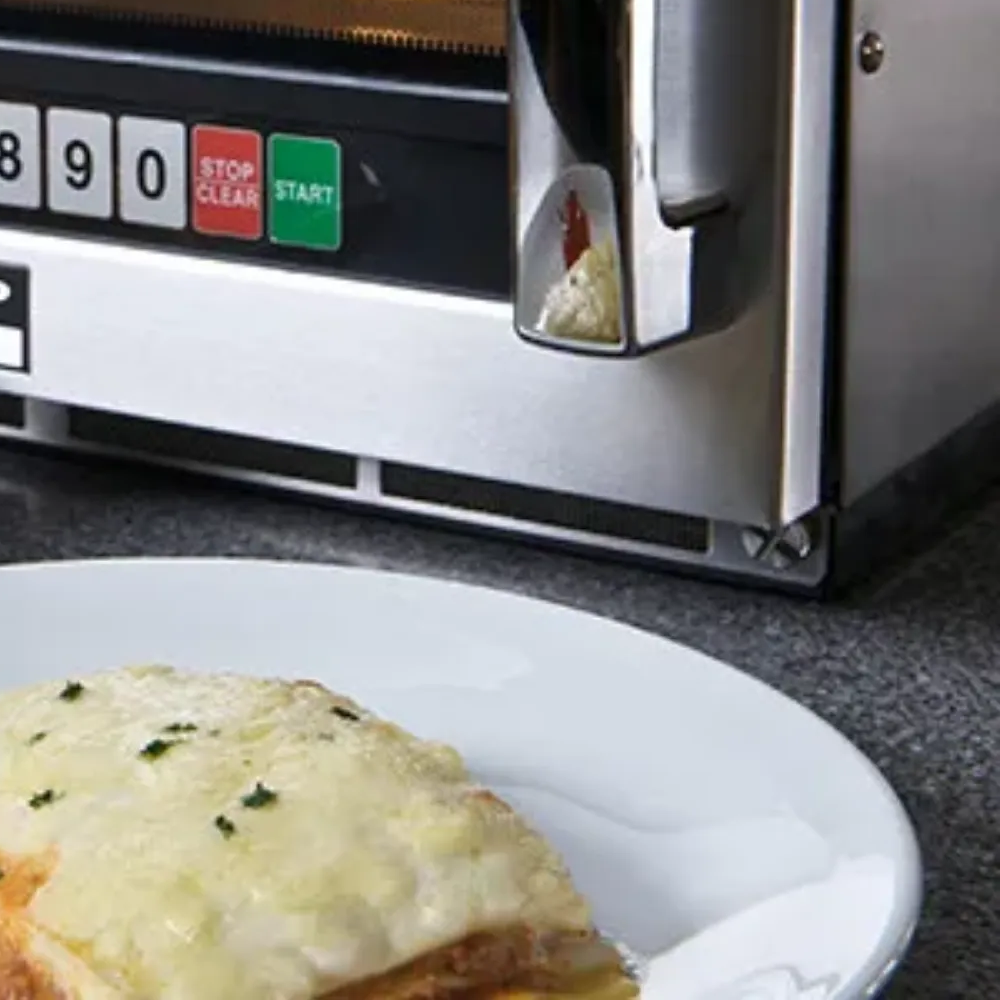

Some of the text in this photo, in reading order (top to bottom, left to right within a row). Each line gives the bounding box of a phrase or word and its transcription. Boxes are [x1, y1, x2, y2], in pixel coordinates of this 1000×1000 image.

[63, 138, 94, 192] 9
[135, 148, 167, 201] 0
[200, 155, 255, 181] STOP
[195, 180, 261, 211] CLEAR
[274, 178, 335, 207] START
